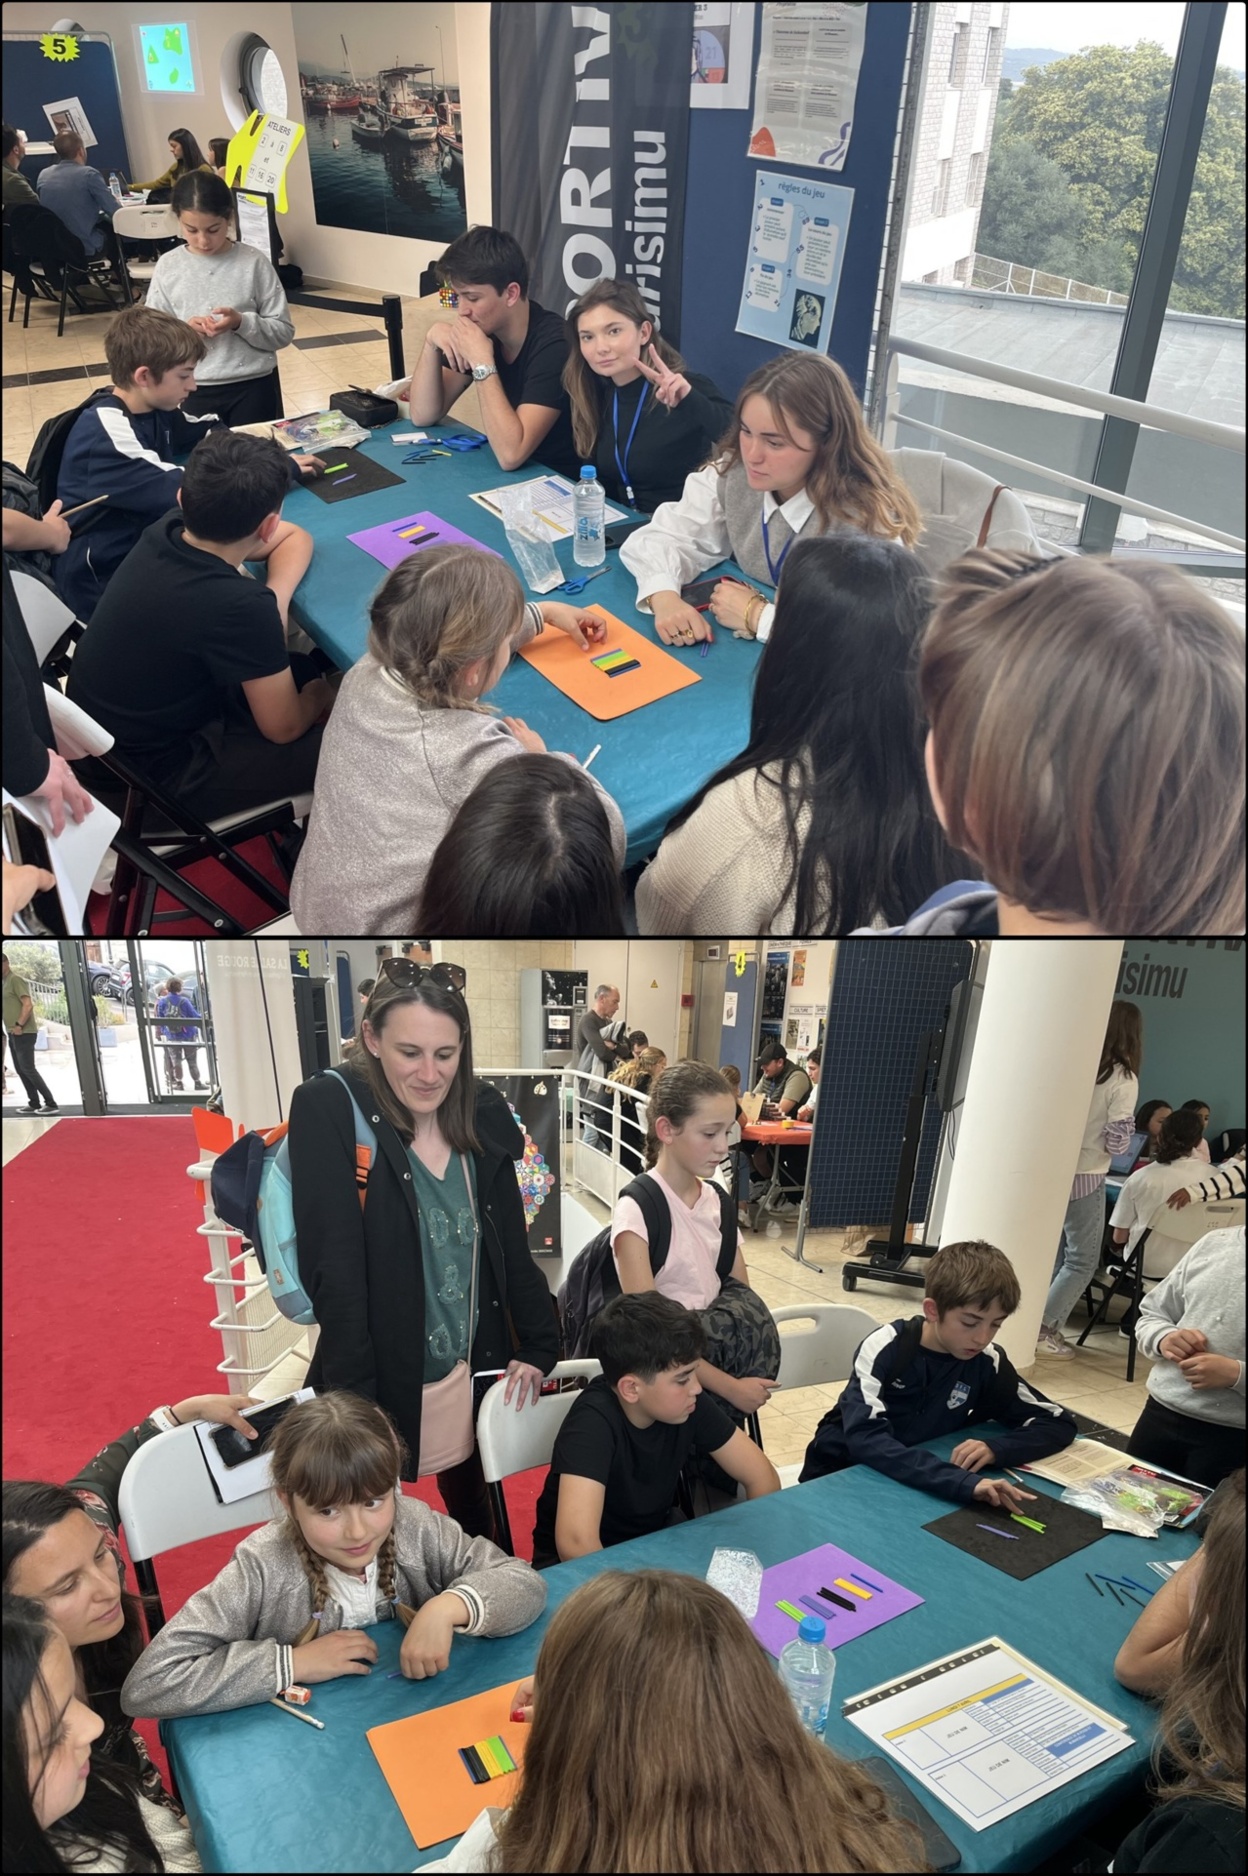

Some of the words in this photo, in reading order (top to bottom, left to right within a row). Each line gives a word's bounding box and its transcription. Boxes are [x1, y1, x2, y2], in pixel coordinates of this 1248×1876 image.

[52, 38, 67, 55] 5
[267, 120, 292, 136] ATELIERS
[267, 175, 274, 184] 20
[778, 182, 800, 194] règles
[802, 186, 812, 196] du
[812, 190, 826, 198] jeu
[625, 131, 667, 332] risimu
